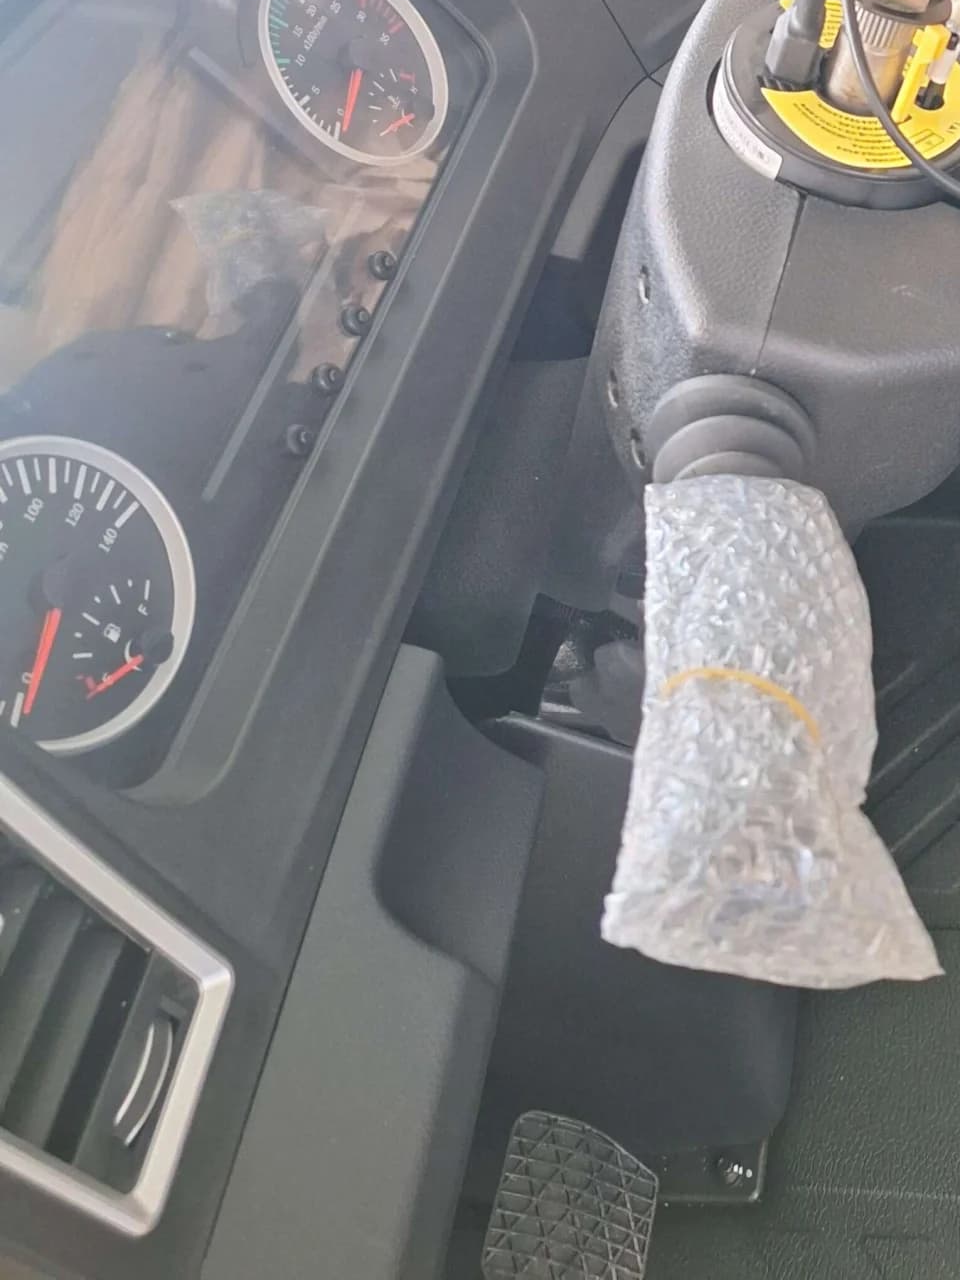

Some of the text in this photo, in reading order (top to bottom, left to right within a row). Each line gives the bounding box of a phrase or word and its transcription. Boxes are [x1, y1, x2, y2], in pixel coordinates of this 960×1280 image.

[292, 25, 303, 38] 15
[295, 53, 306, 66] 10
[311, 85, 320, 95] 5
[23, 498, 43, 522] 100
[65, 503, 84, 526] 120
[98, 527, 118, 553] 140
[137, 603, 149, 616] F
